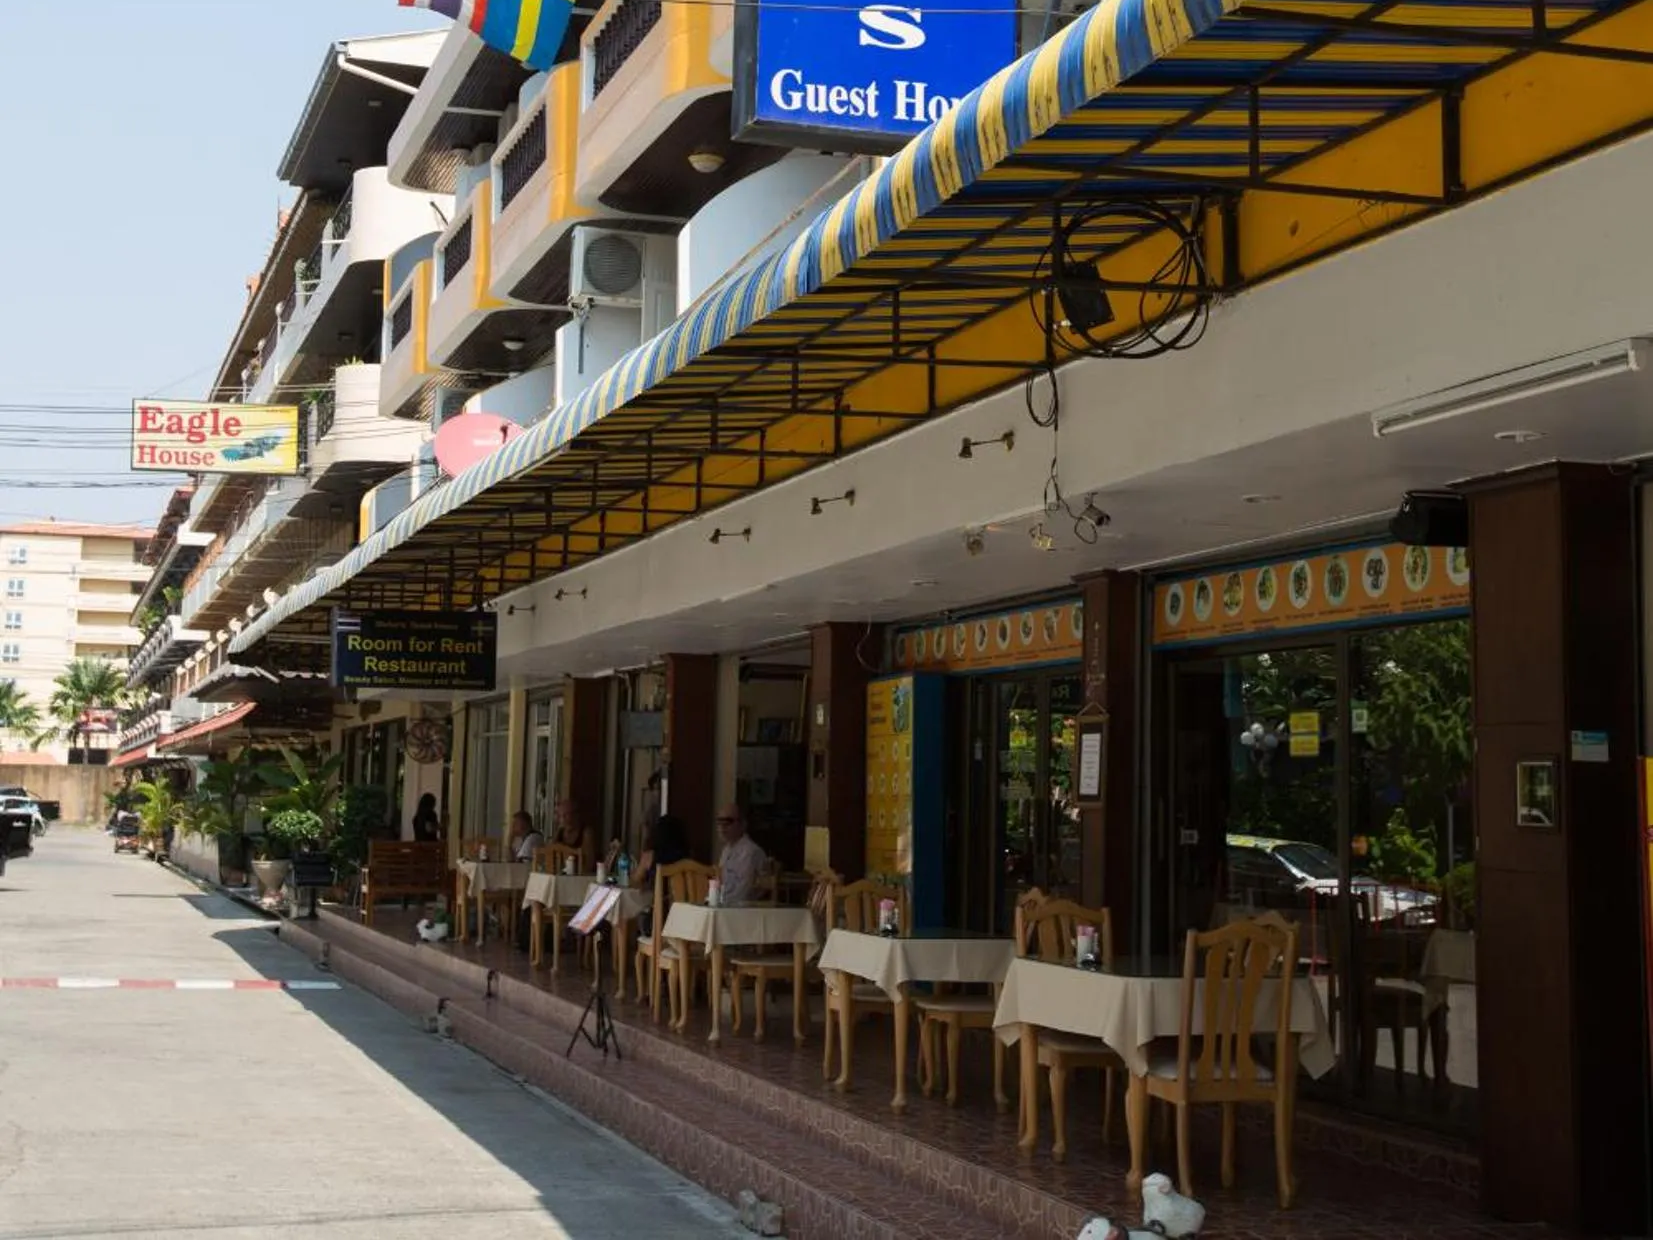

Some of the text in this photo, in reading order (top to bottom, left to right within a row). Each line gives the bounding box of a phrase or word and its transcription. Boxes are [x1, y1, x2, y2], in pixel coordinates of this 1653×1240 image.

[770, 68, 962, 123] Guest Ho
[138, 406, 242, 443] Eagle
[138, 445, 215, 466] House
[347, 635, 484, 654] Room for Rent
[364, 655, 466, 675] Restaurant
